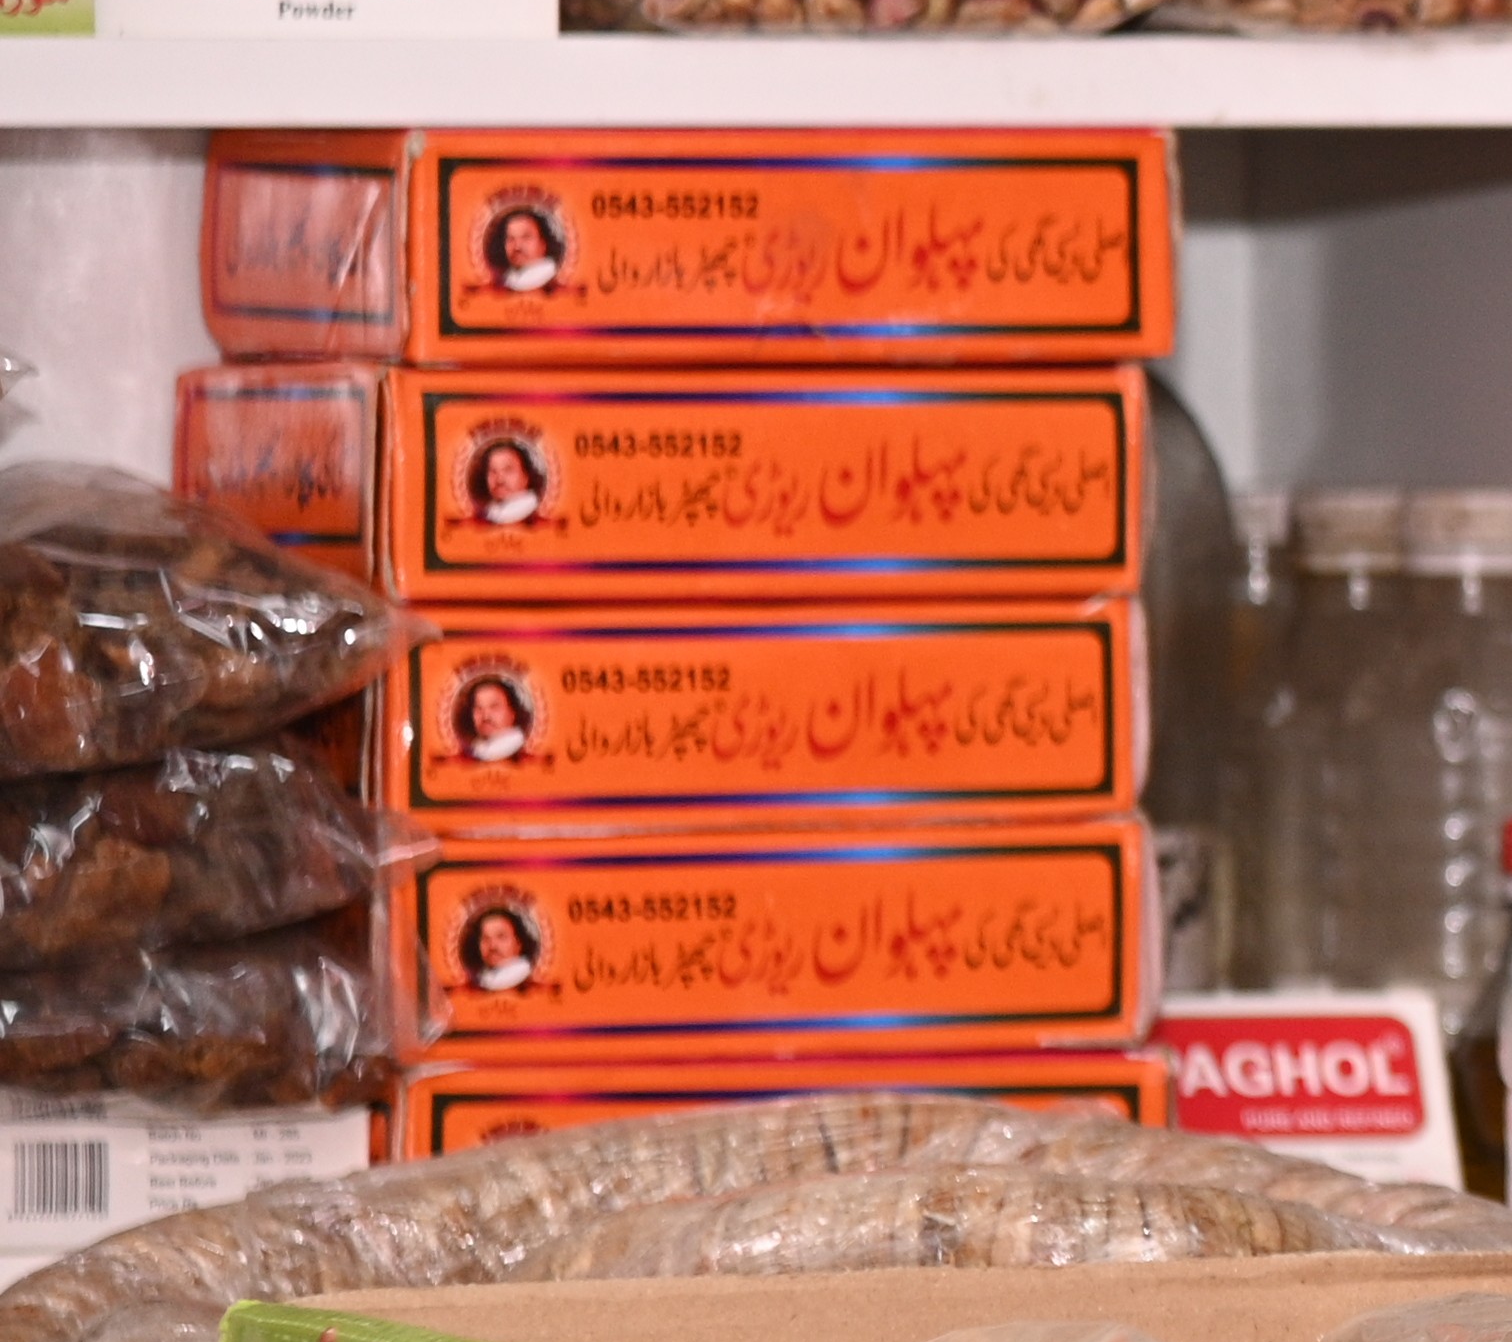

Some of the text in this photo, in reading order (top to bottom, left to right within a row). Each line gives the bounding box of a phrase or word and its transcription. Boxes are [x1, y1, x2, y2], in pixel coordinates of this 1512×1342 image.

[278, 1, 356, 21] Powder
[591, 194, 759, 219] 0543-552152
[574, 433, 743, 459] 0543-552152
[562, 667, 730, 693] 0543-552152
[568, 896, 736, 922] 0543-552152
[1168, 1039, 1412, 1099] AGHOL
